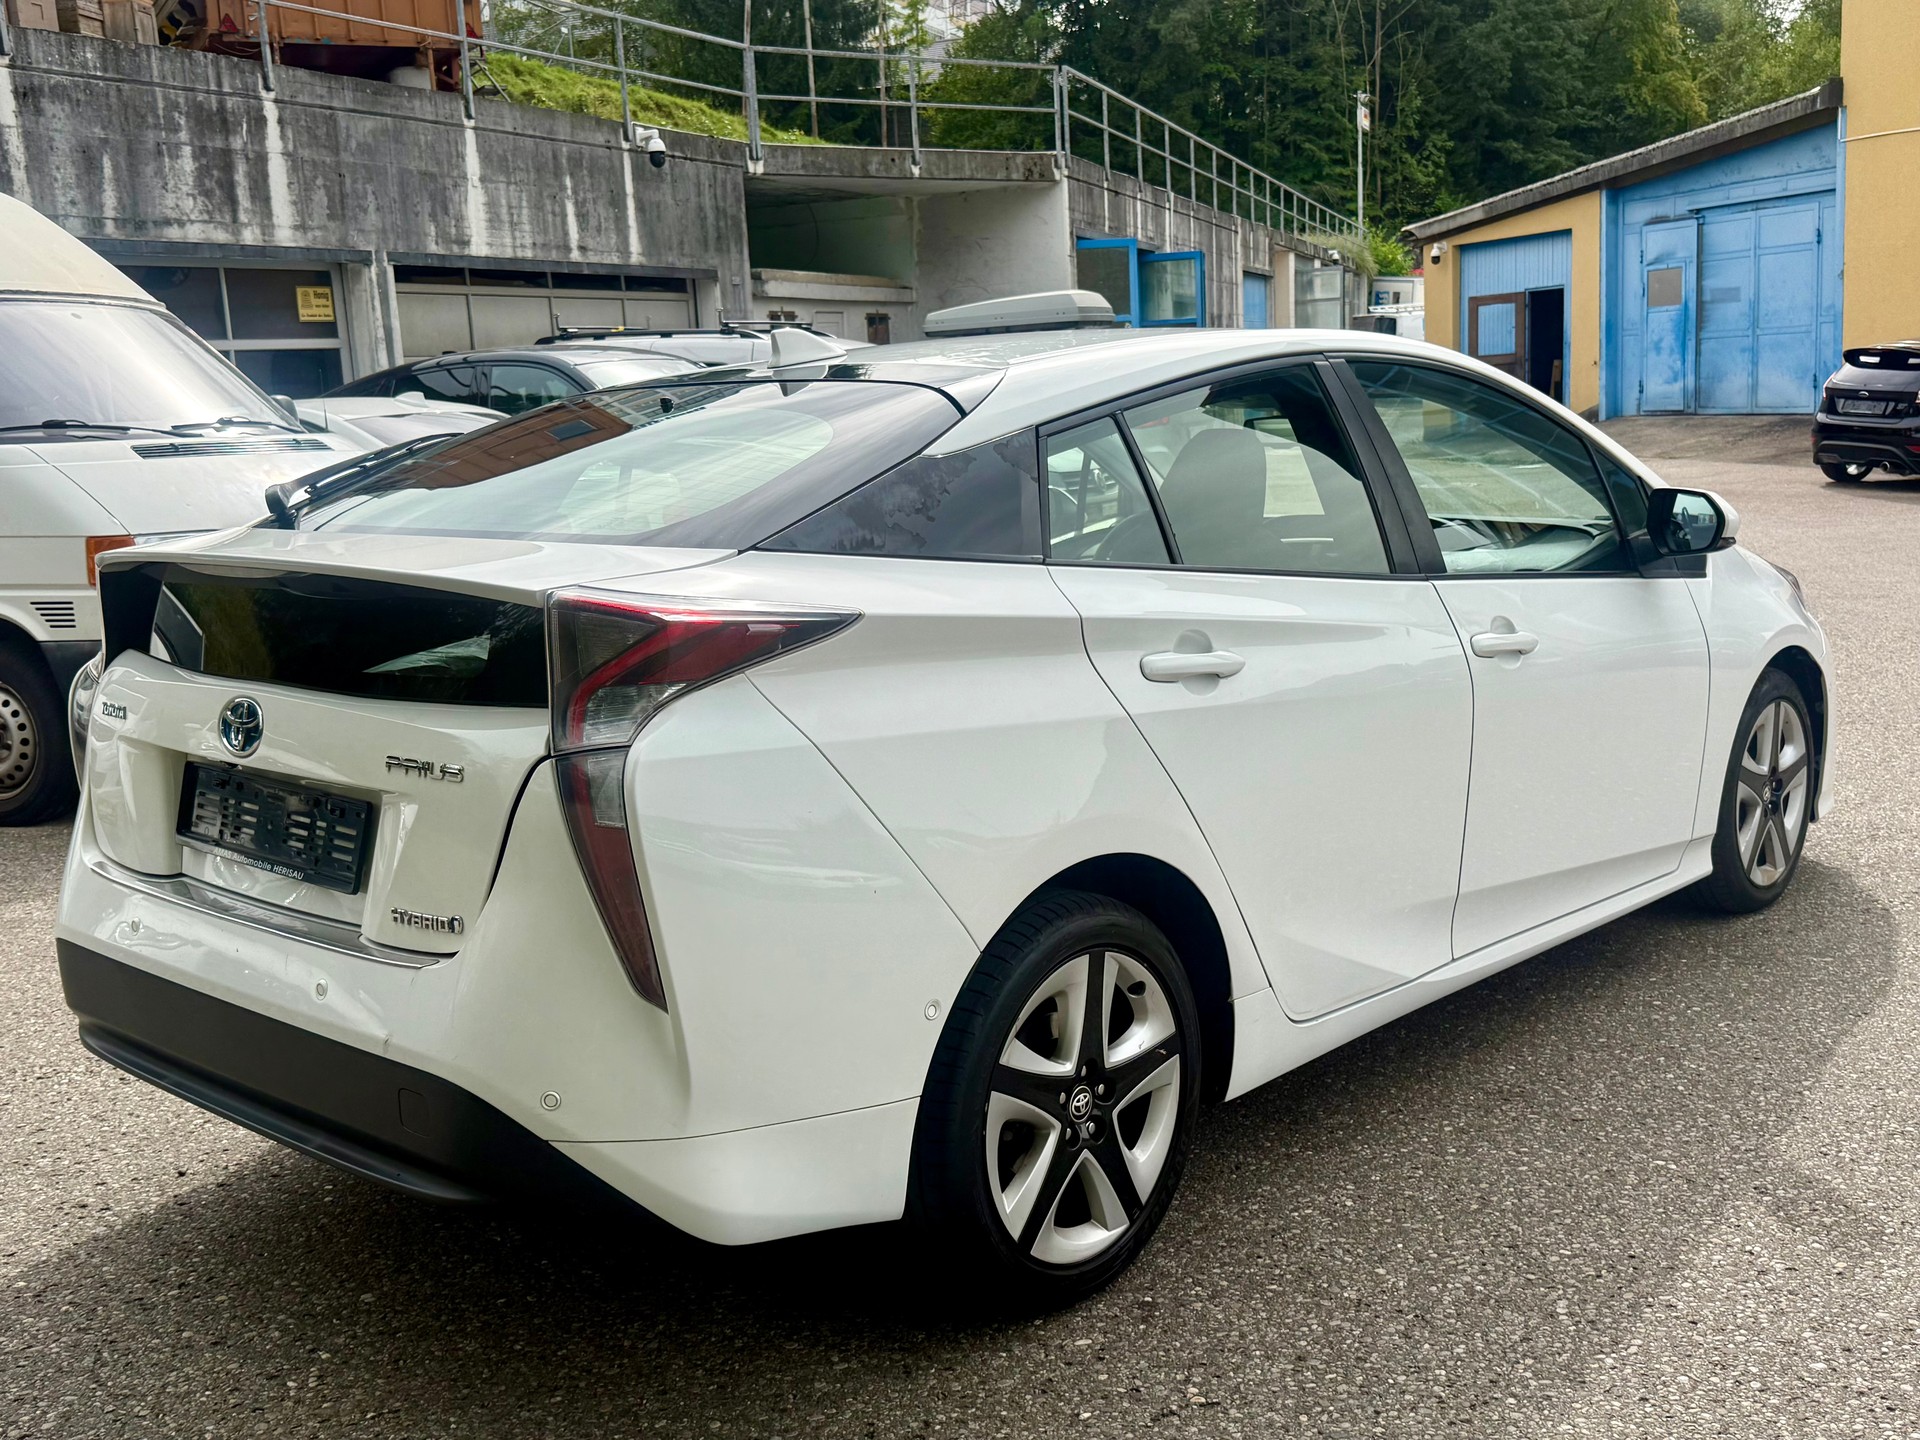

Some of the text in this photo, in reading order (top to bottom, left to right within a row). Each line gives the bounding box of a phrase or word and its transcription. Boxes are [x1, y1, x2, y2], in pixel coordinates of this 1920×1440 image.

[102, 701, 126, 720] TOYOTA
[385, 755, 464, 783] PRIUS
[213, 847, 305, 880] AMAS Automobile HERISAU
[391, 906, 450, 934] HYBRID
